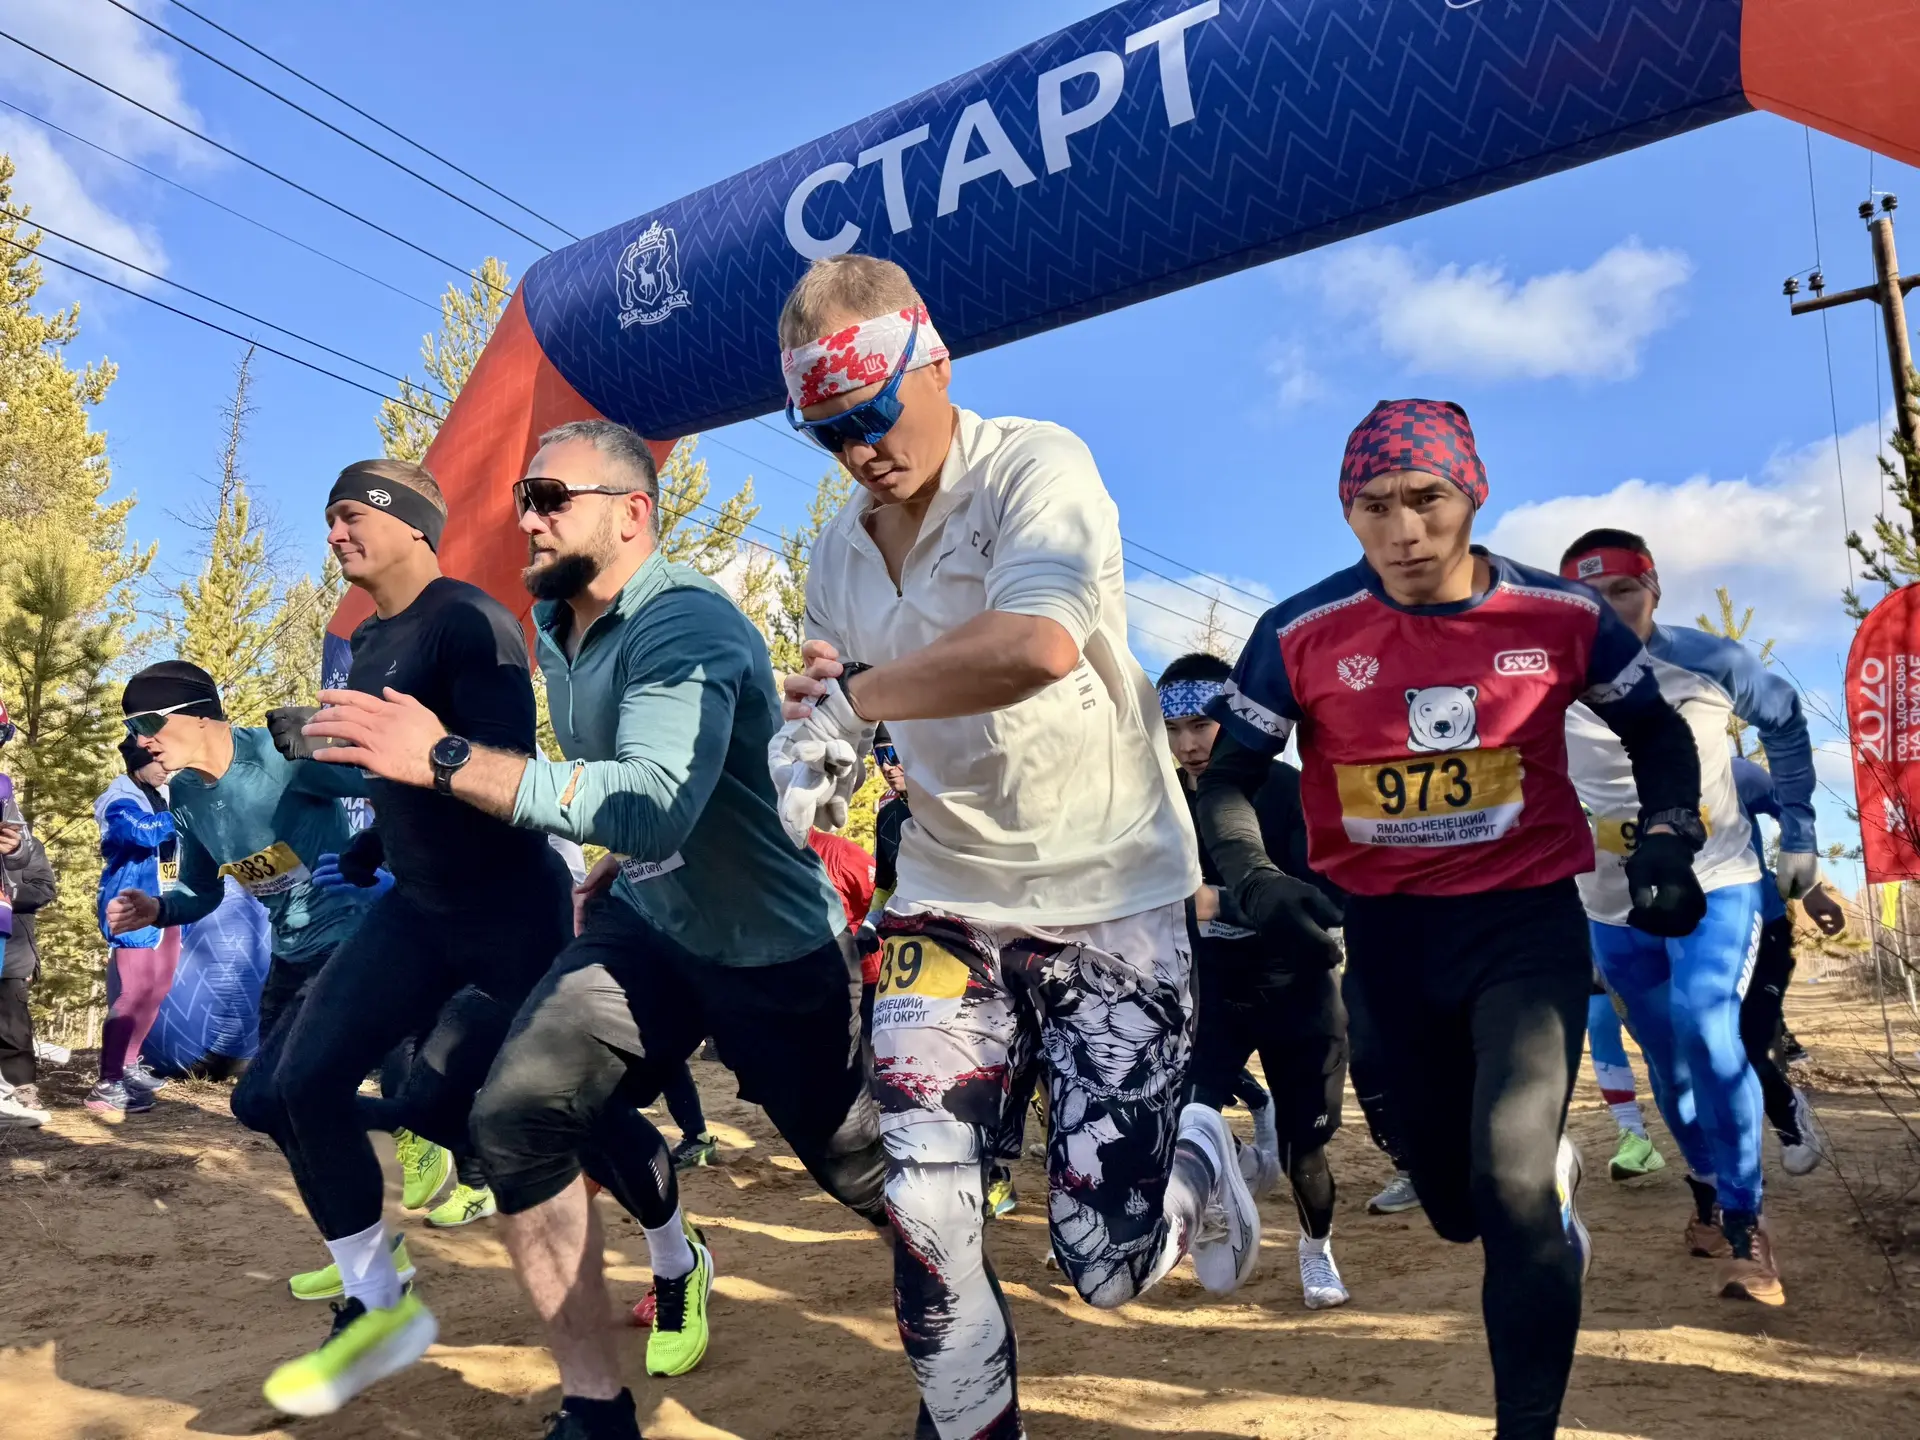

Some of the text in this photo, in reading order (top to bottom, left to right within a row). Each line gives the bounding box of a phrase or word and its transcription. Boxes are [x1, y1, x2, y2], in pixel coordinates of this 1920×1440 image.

[784, 2, 1220, 259] СТАРТ
[1895, 654, 1908, 762] ГОД ЗДОРОВЬЯ
[1376, 758, 1472, 815] 973
[1371, 824, 1497, 844] АВТОНОМНЫЙ ОКРУГ
[1376, 811, 1487, 834] ЯМАЛО-НЕНЕЦКИЙ
[233, 854, 275, 881] 383
[893, 1010, 930, 1023] ОКРУГ
